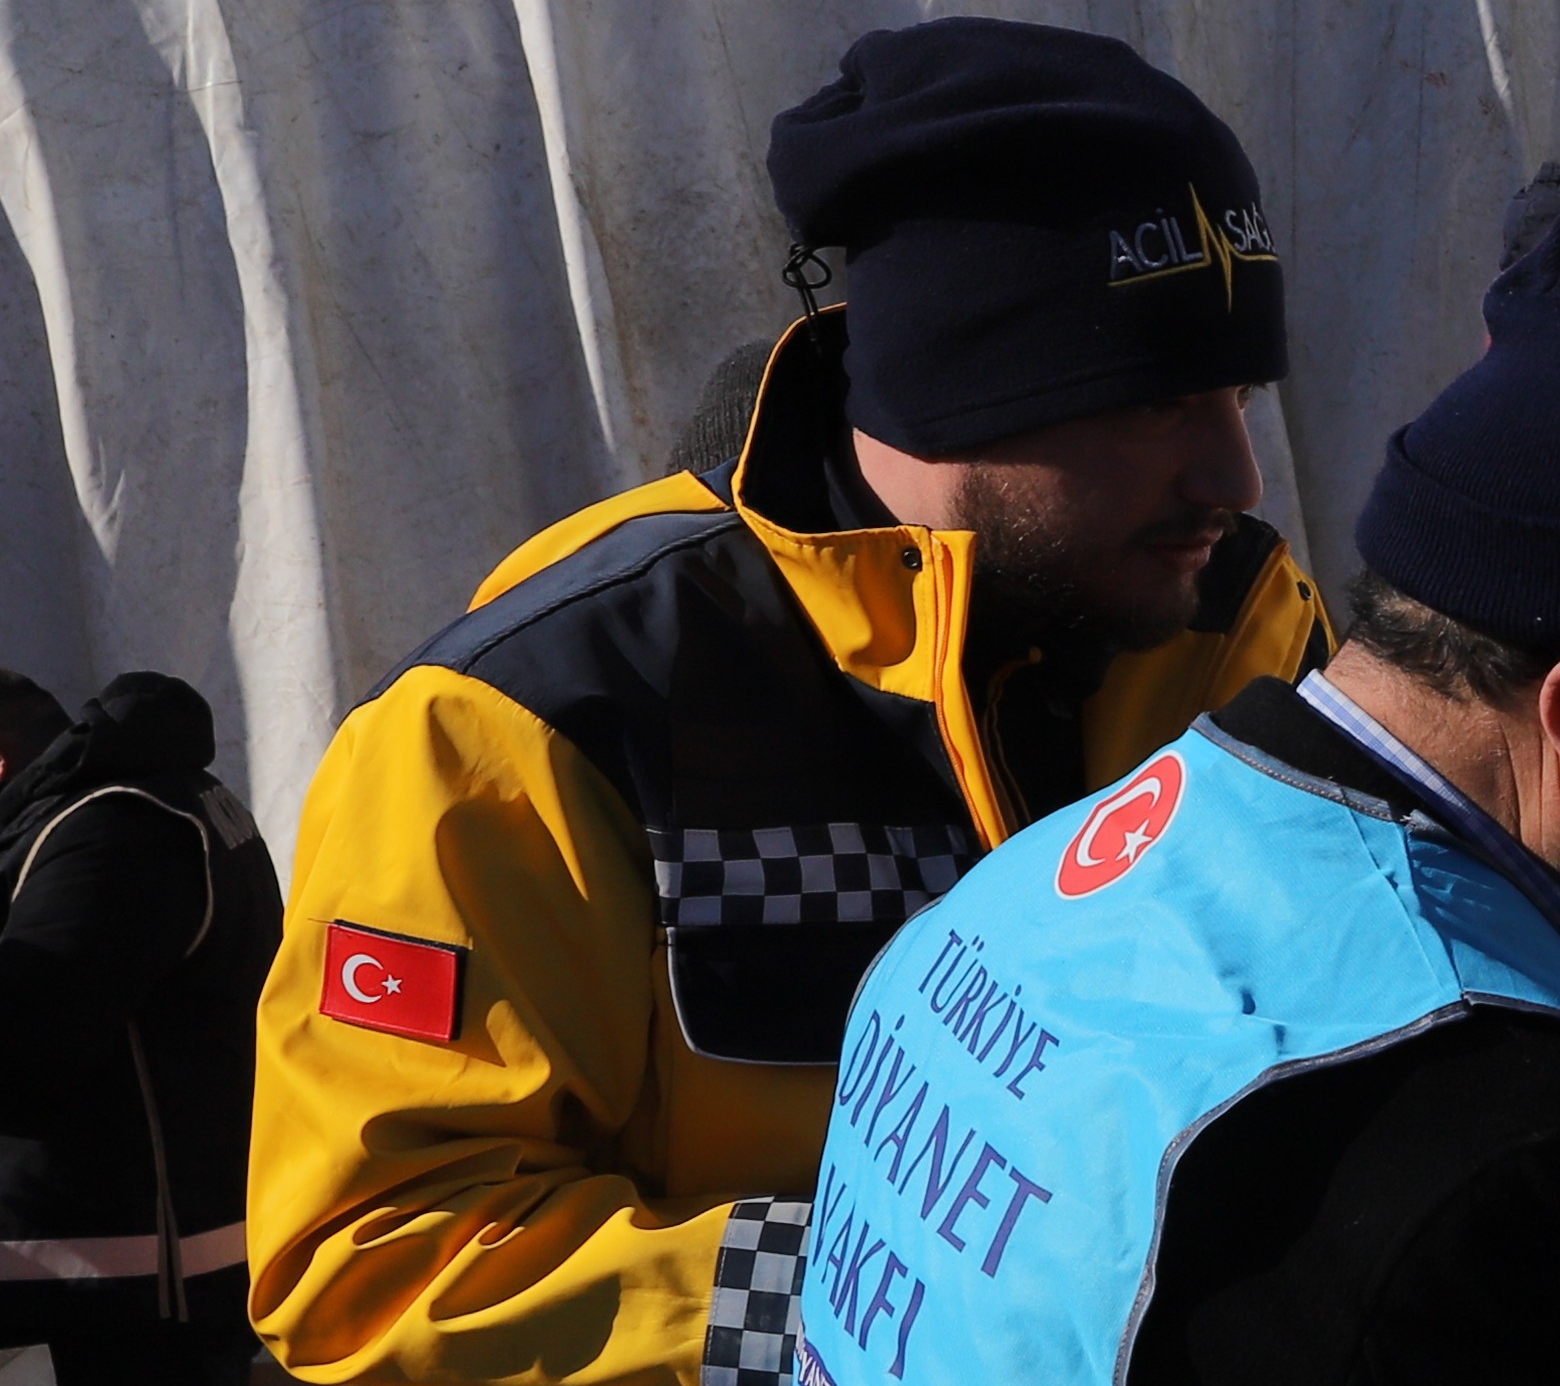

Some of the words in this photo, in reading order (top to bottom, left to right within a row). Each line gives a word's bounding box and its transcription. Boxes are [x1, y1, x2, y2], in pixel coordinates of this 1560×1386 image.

[1109, 208, 1204, 280] ACİL
[917, 929, 1061, 1101] TÜRKİYE
[838, 1009, 1054, 1280] DİYANET
[812, 1163, 926, 1381] VAKFI
